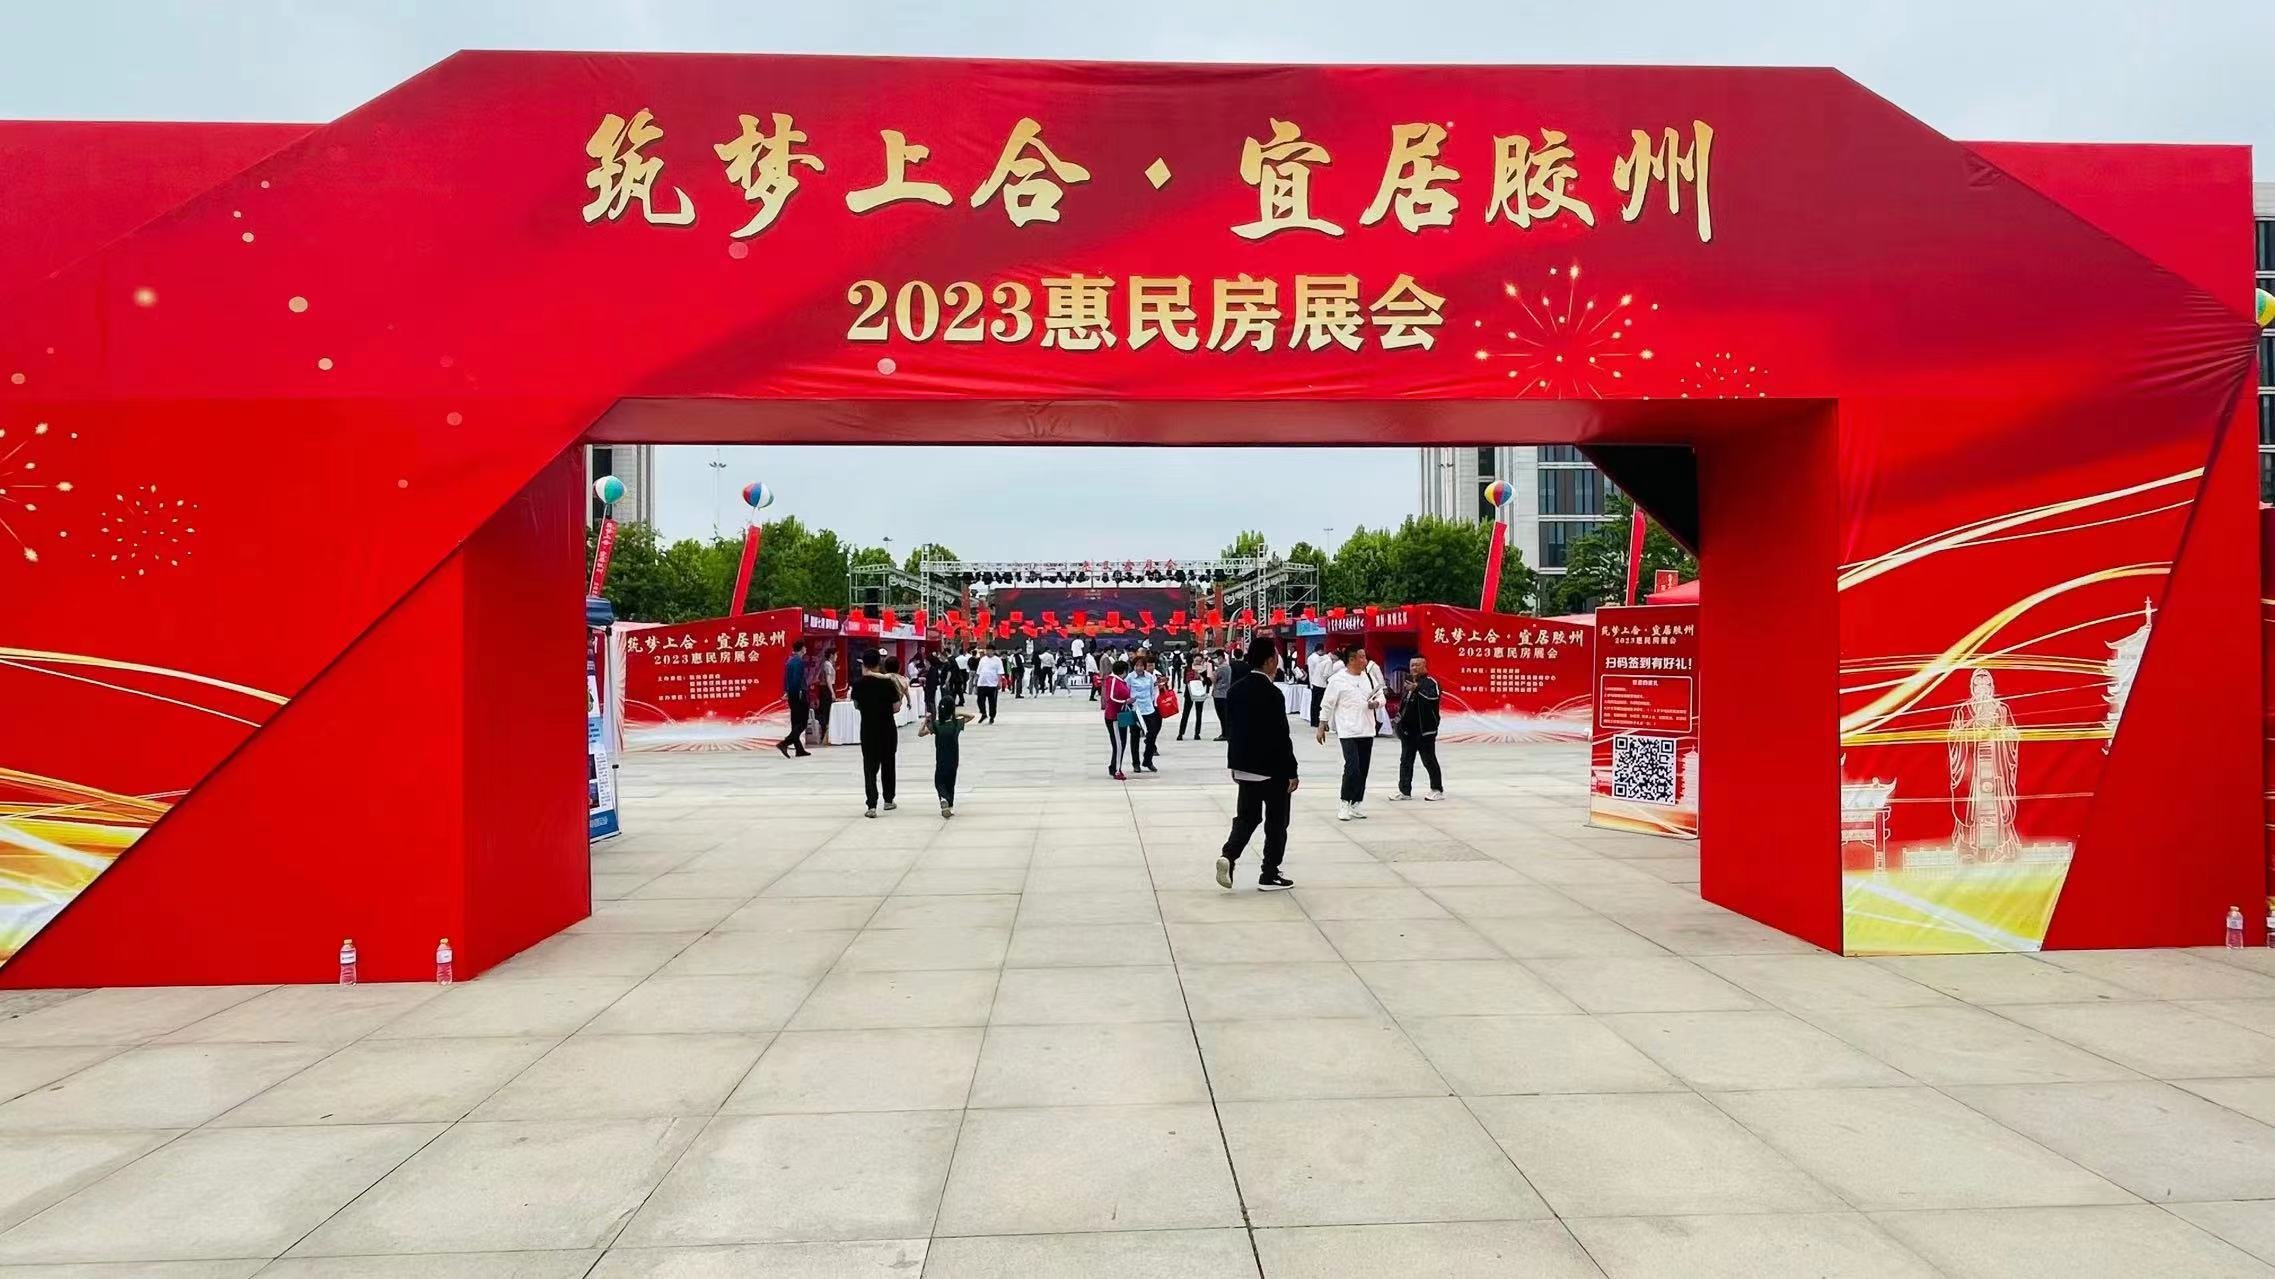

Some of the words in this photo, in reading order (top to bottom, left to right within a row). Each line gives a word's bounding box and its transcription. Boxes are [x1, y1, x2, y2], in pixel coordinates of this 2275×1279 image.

[582, 109, 1714, 243] 筑梦上合·宜居胶州
[846, 272, 1446, 352] 2023惠民房展会
[654, 649, 760, 665] 2023惠民房展会
[1458, 646, 1558, 659] 2023惠民房展会
